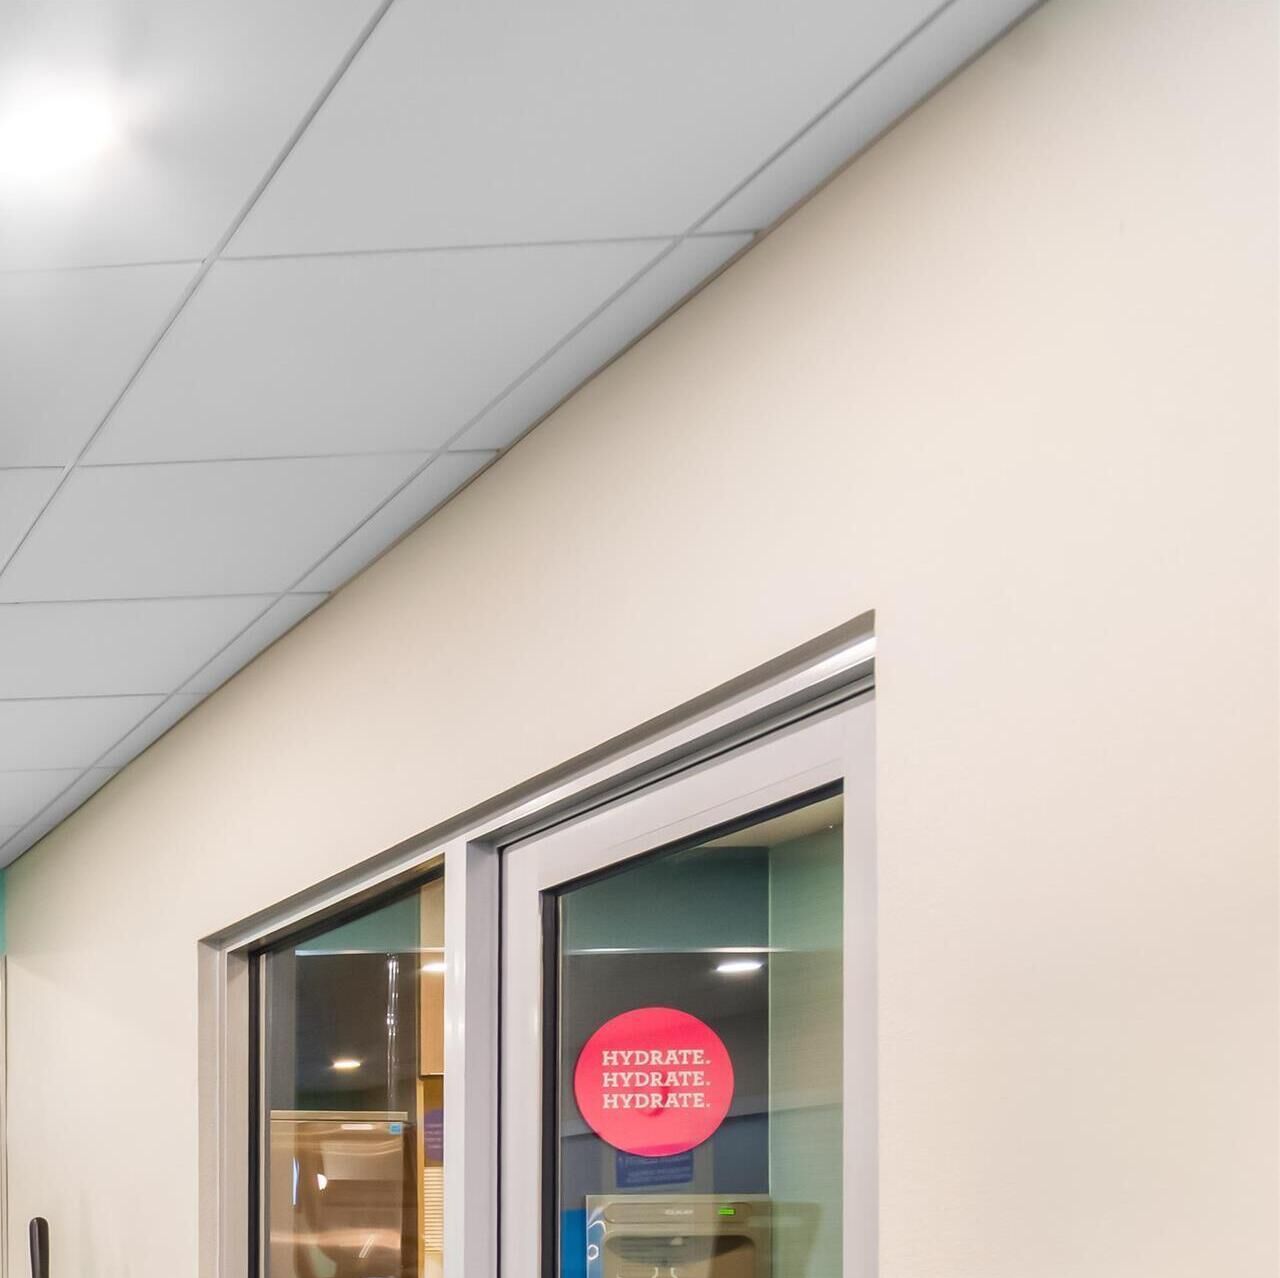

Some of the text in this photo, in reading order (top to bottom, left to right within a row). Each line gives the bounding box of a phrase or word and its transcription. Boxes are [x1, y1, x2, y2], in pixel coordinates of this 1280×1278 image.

[602, 1049, 711, 1066] HYDRATE.
[602, 1071, 711, 1088] HYDRATE.
[602, 1093, 711, 1109] HYDRATE.
